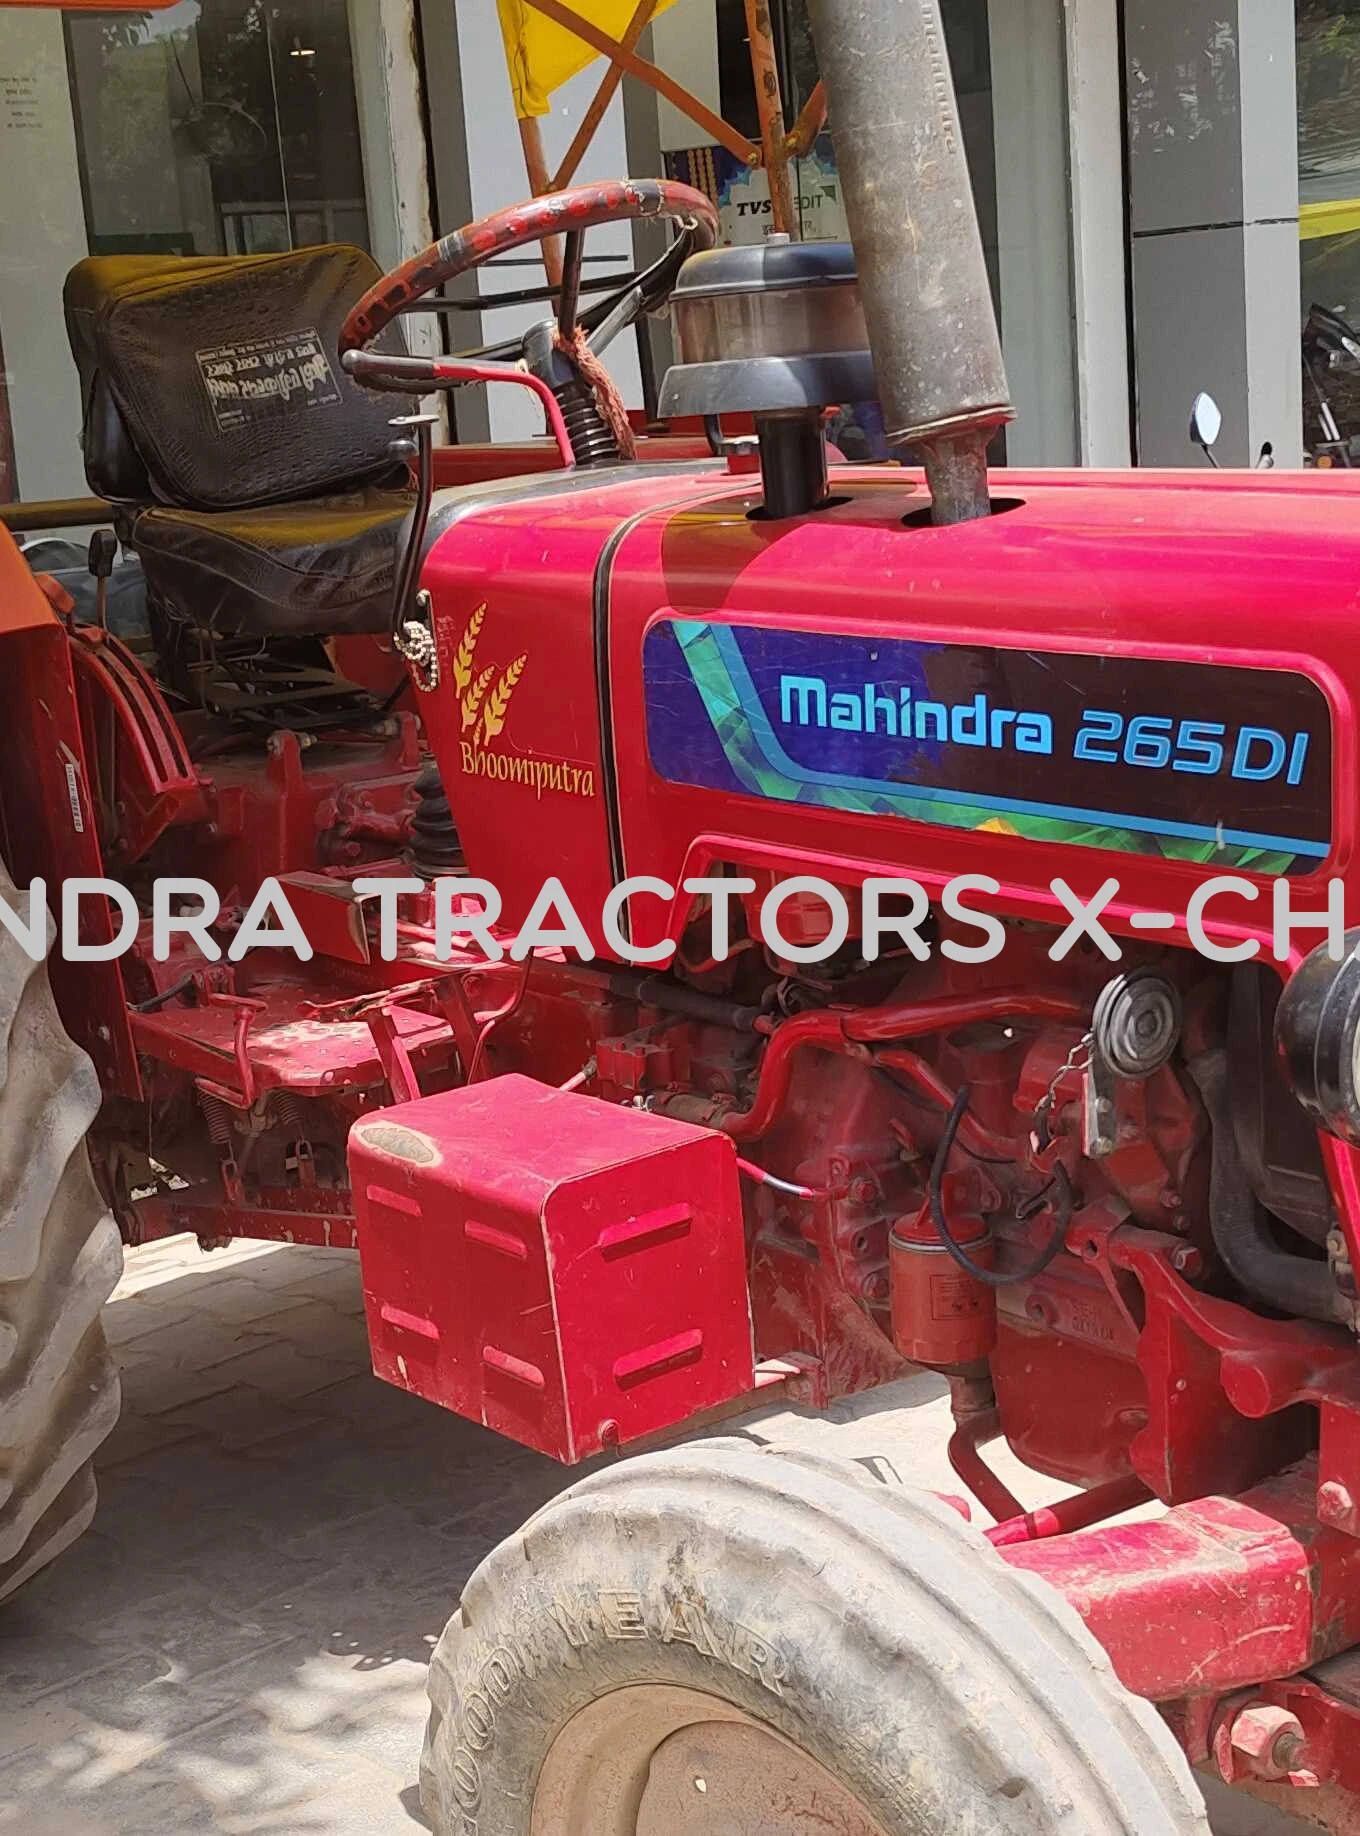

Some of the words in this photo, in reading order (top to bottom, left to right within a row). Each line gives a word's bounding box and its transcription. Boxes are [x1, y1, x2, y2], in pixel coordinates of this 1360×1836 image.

[736, 199, 772, 216] TVS
[781, 674, 1053, 755] Mahindra
[460, 740, 595, 800] Bhoomiputra
